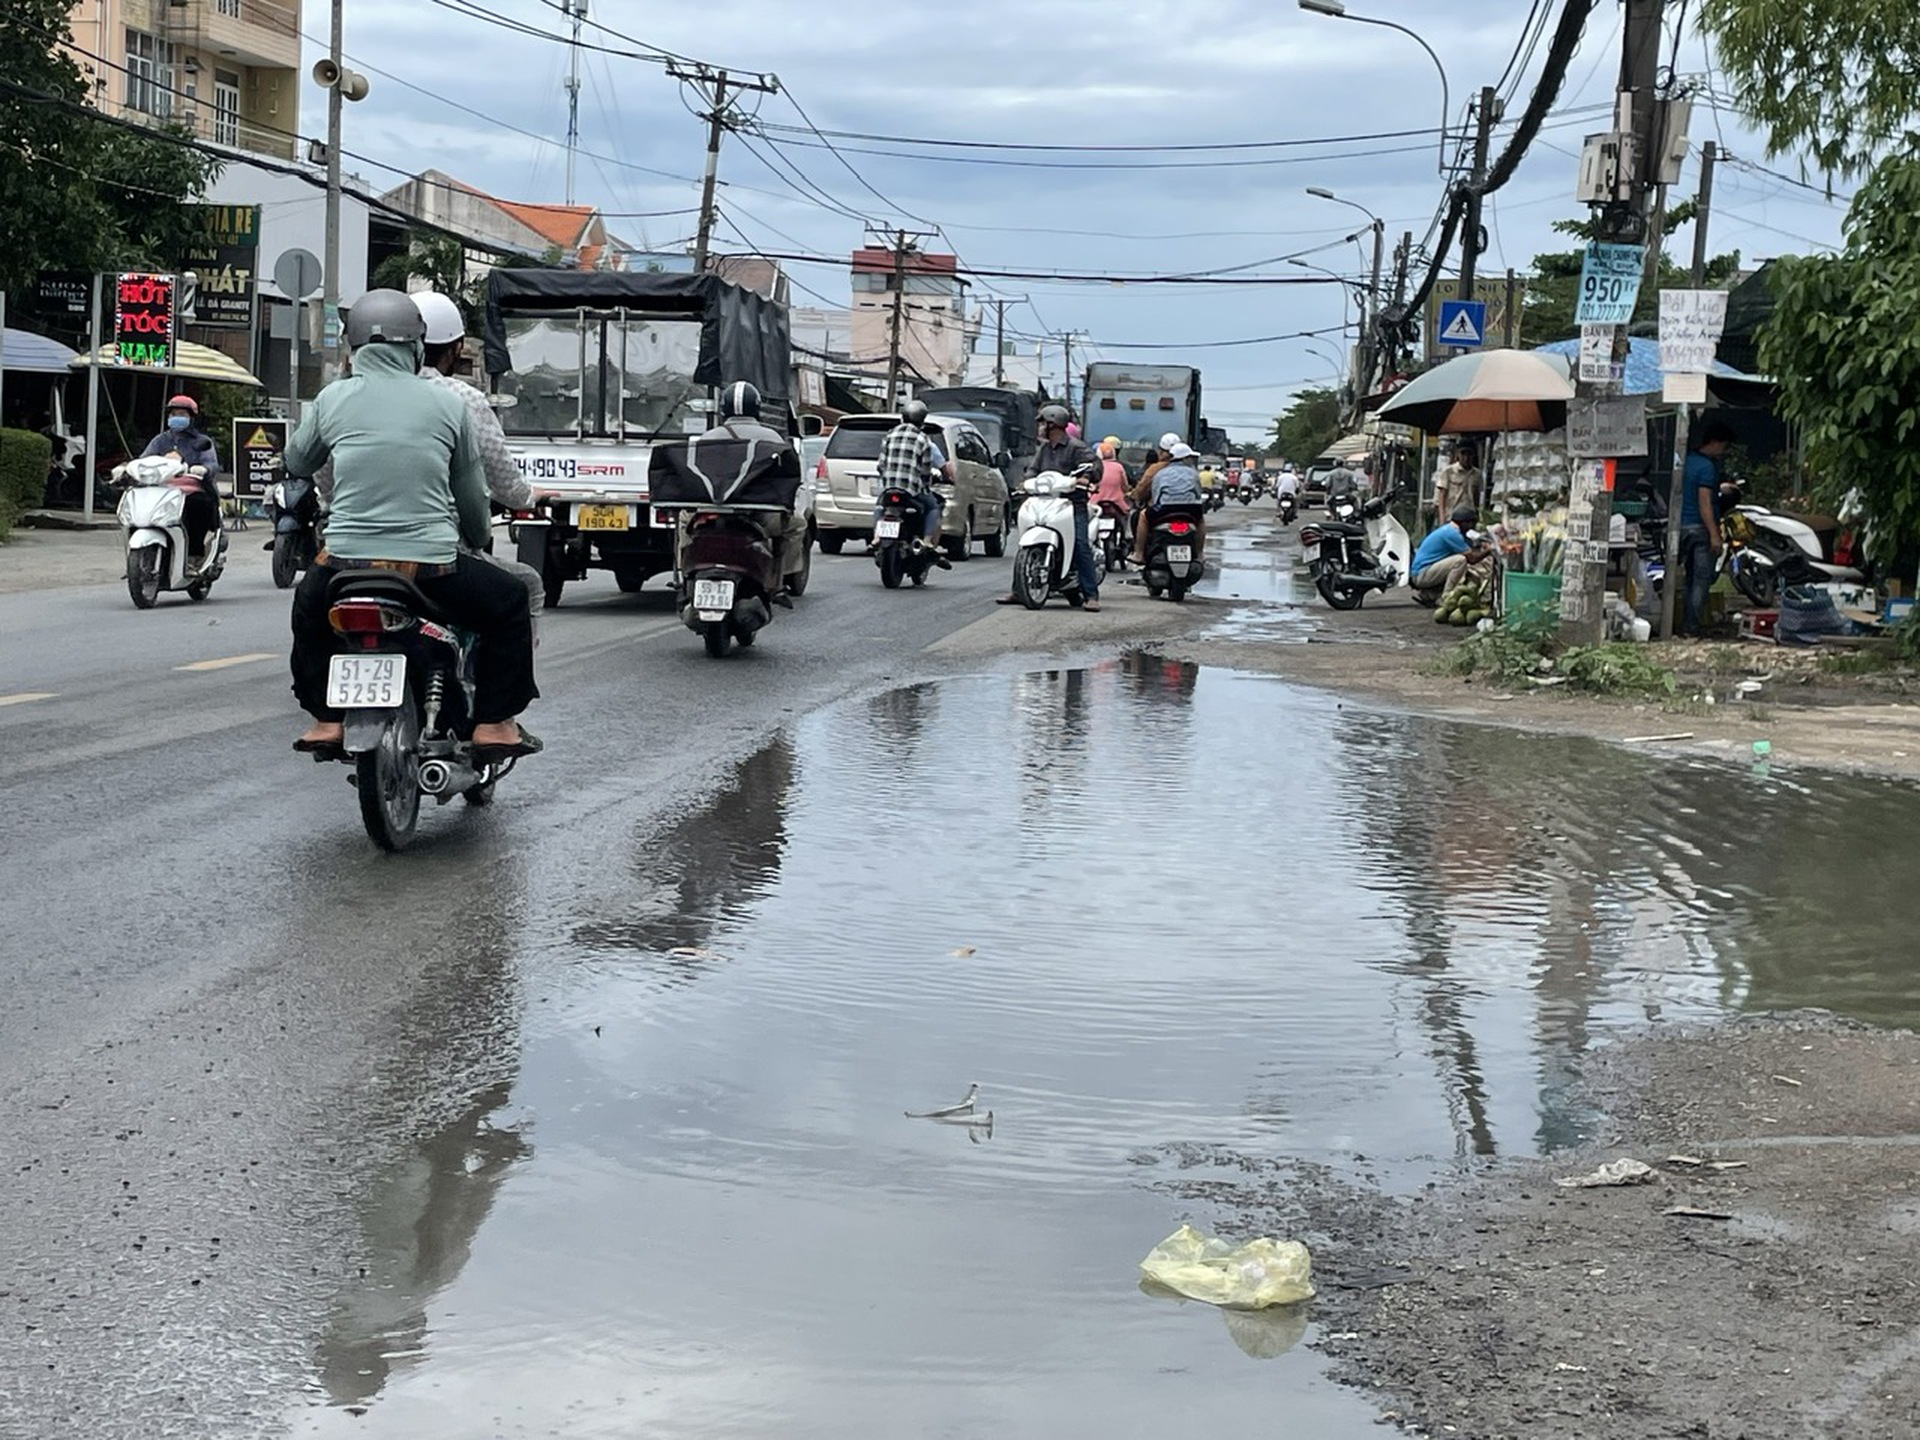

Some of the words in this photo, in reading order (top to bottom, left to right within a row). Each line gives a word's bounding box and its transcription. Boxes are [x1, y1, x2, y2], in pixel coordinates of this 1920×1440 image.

[1585, 275, 1622, 303] 950
[120, 310, 169, 334] TÓC
[120, 343, 168, 362] NAM
[577, 465, 625, 477] SRM
[339, 682, 392, 704] 5255
